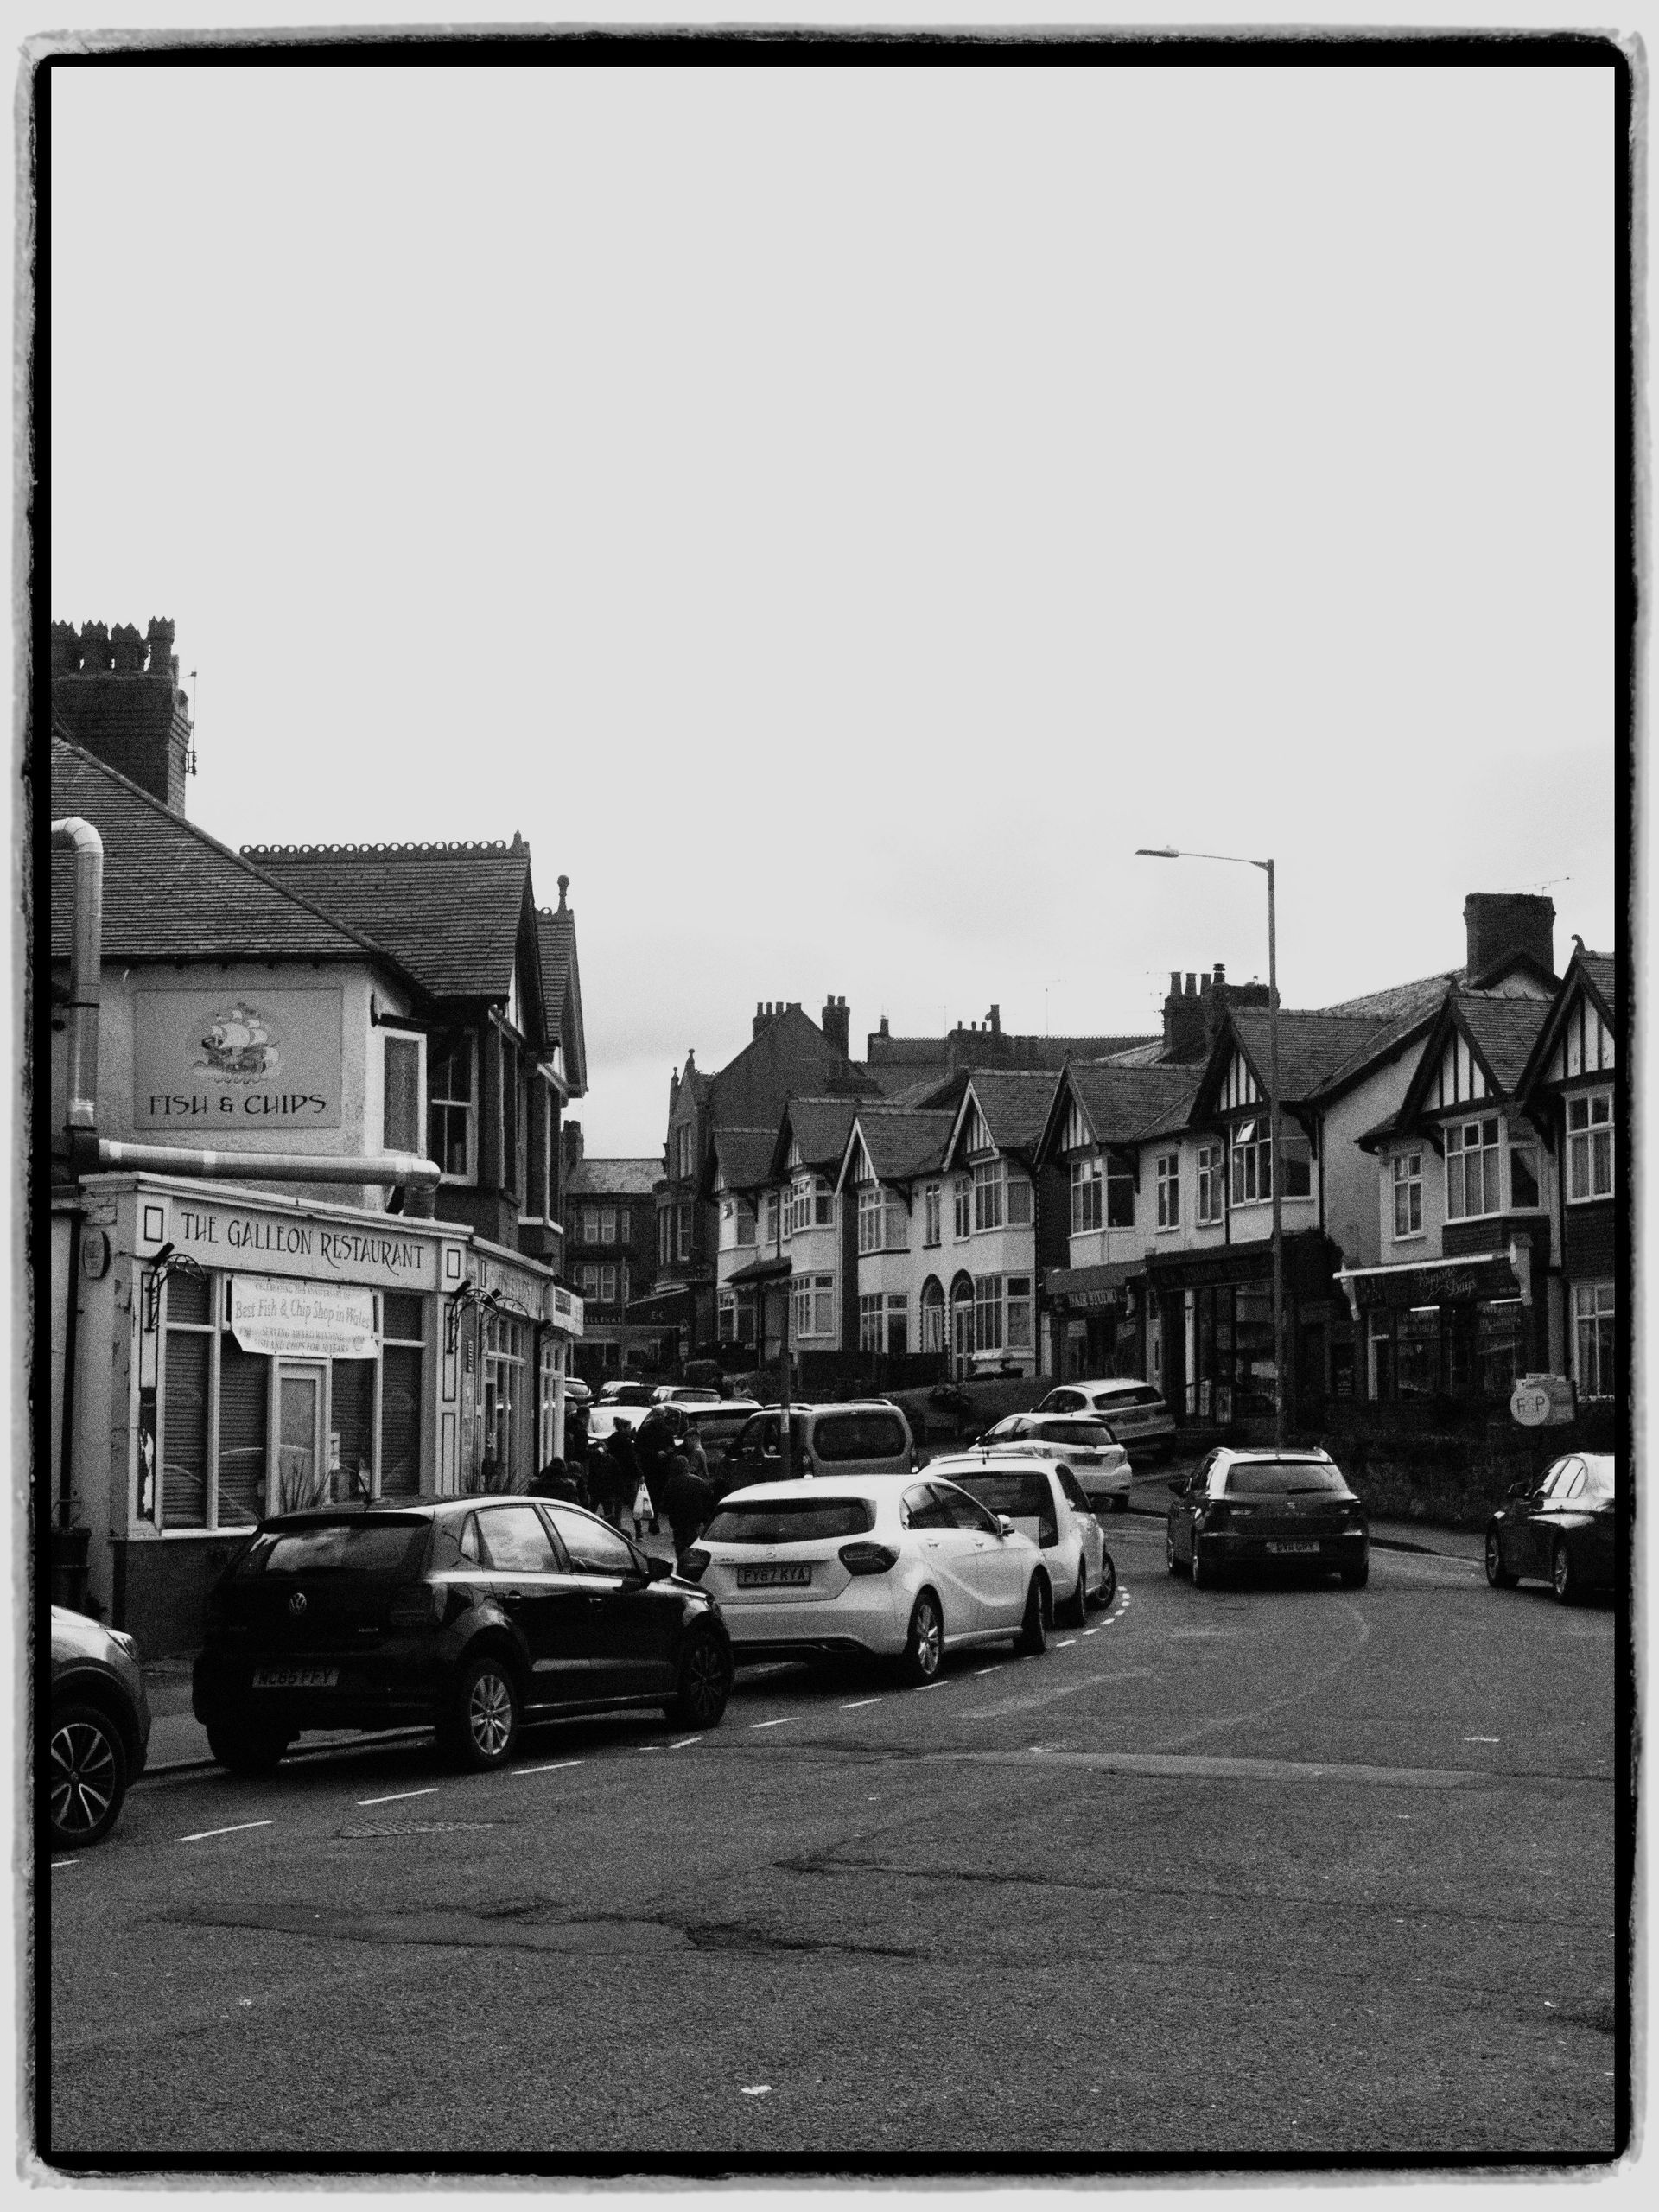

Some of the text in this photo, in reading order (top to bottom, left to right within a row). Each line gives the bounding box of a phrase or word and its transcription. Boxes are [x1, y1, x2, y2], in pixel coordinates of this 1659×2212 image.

[149, 1093, 327, 1116] FISH & CHIPS
[181, 1212, 424, 1276] THE GALLEON RESTAURANT
[235, 1298, 372, 1329] Best Fish & Chip Shop in Wales
[743, 1567, 804, 1582] FY67 KYA
